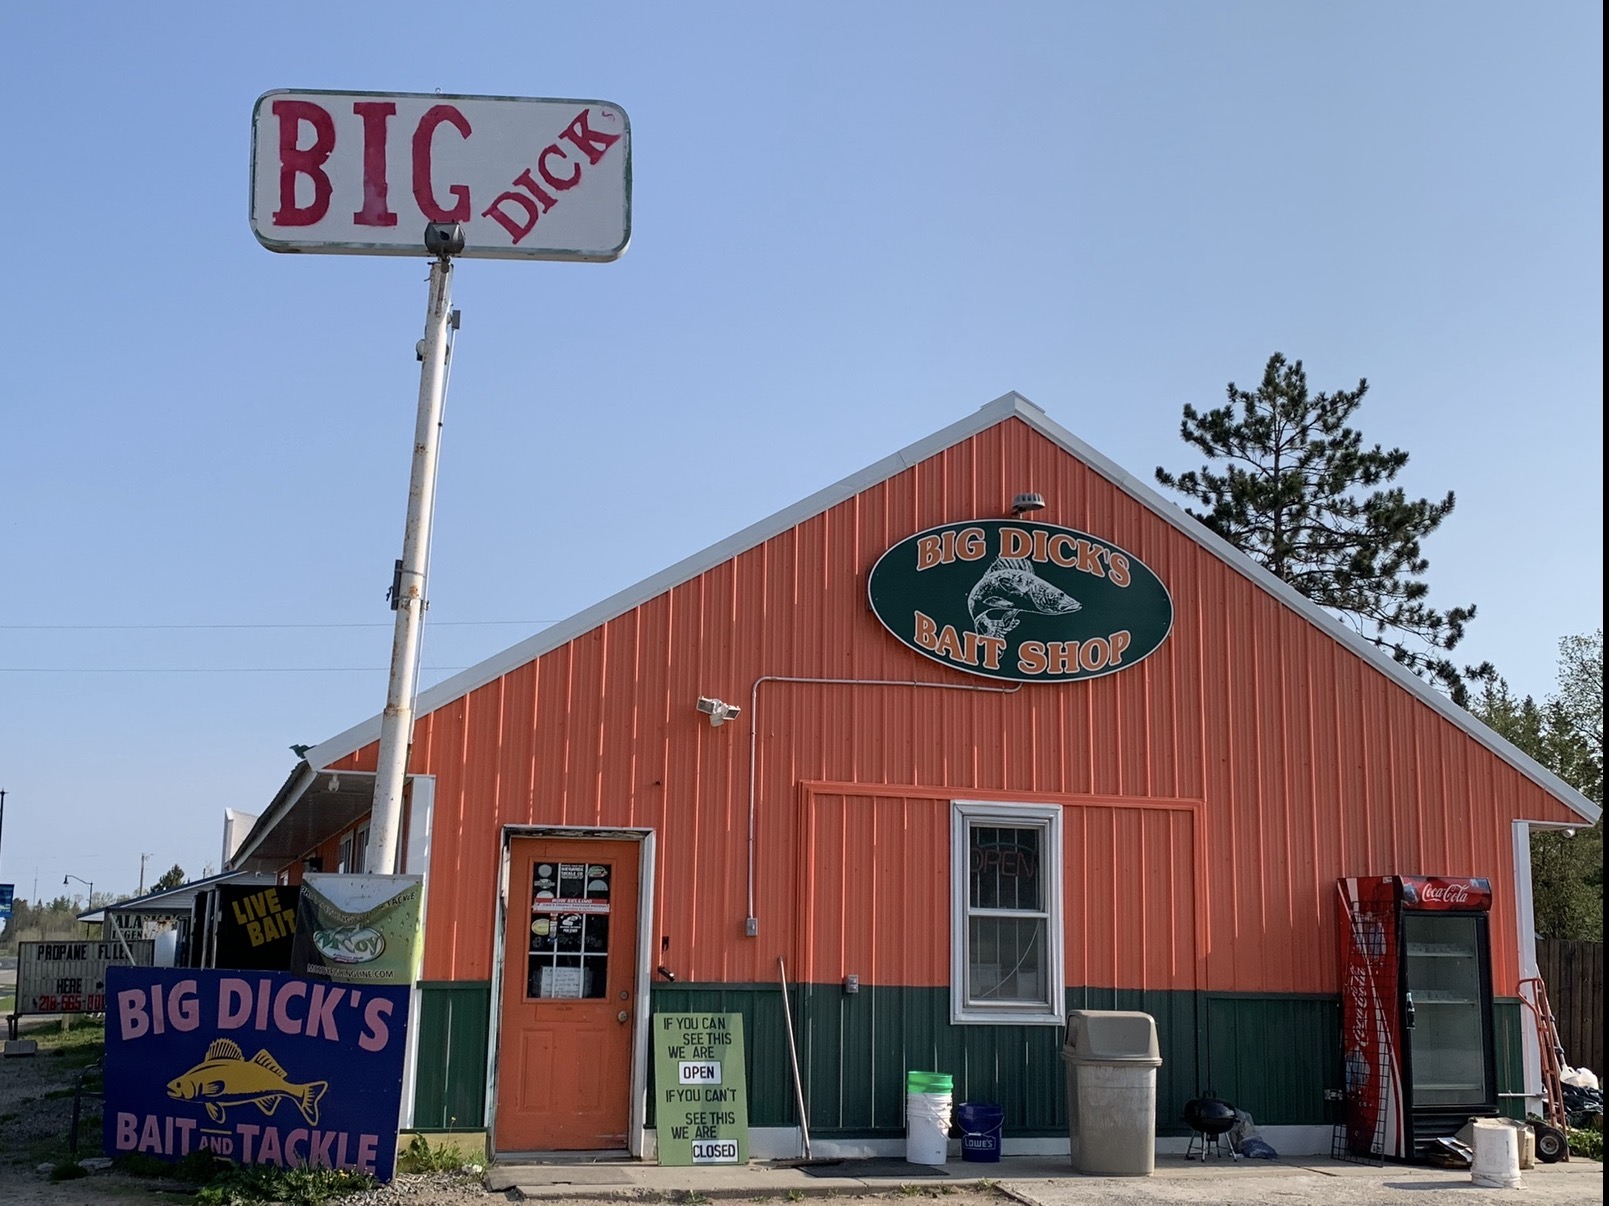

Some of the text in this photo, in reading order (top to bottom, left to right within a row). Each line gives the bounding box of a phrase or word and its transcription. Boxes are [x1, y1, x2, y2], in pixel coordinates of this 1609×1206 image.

[272, 100, 472, 226] BIG
[916, 527, 1131, 588] BIG DICK'S
[913, 610, 1131, 675] BAIT SHOP
[970, 850, 1036, 880] OPEN
[1422, 883, 1469, 902] Coca-Cola
[232, 888, 281, 925] LIVE
[246, 908, 296, 947] BAIT
[37, 944, 87, 961] PROPANE
[57, 978, 82, 994] HERE
[117, 978, 394, 1052] BIG DICK'S
[663, 1017, 726, 1030] IF YOU CAN
[683, 1032, 732, 1045] SEE THIS
[668, 1046, 715, 1059] WE ARE
[683, 1066, 715, 1079] OPEN
[666, 1087, 737, 1103] IF YOU CAN'T
[685, 1111, 736, 1125] SEE THIS
[671, 1125, 717, 1139] WE ARE
[116, 1112, 379, 1175] BAIT AND TACKLE
[693, 1144, 736, 1158] CLOSED
[964, 1138, 993, 1148] LOWE'S
